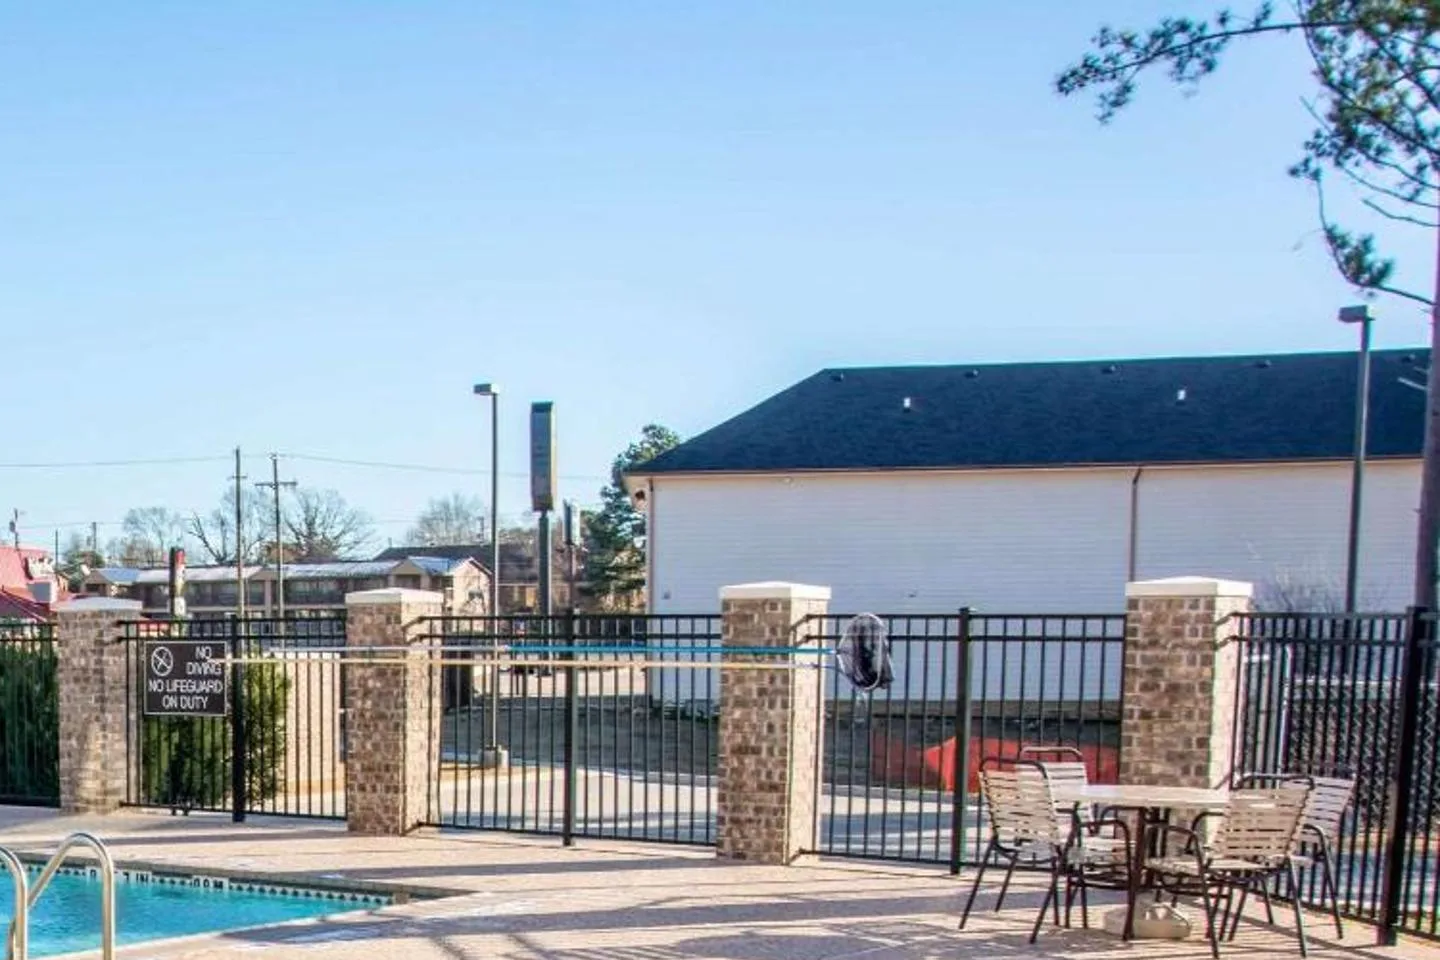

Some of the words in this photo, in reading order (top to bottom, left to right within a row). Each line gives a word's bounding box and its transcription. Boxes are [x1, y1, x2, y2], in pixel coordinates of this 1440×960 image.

[195, 646, 211, 660] NO
[186, 661, 222, 675] DIVING
[149, 679, 164, 692] NO
[167, 679, 223, 693] LIFEGUARD
[162, 696, 177, 709] ON
[180, 696, 208, 709] DUTY
